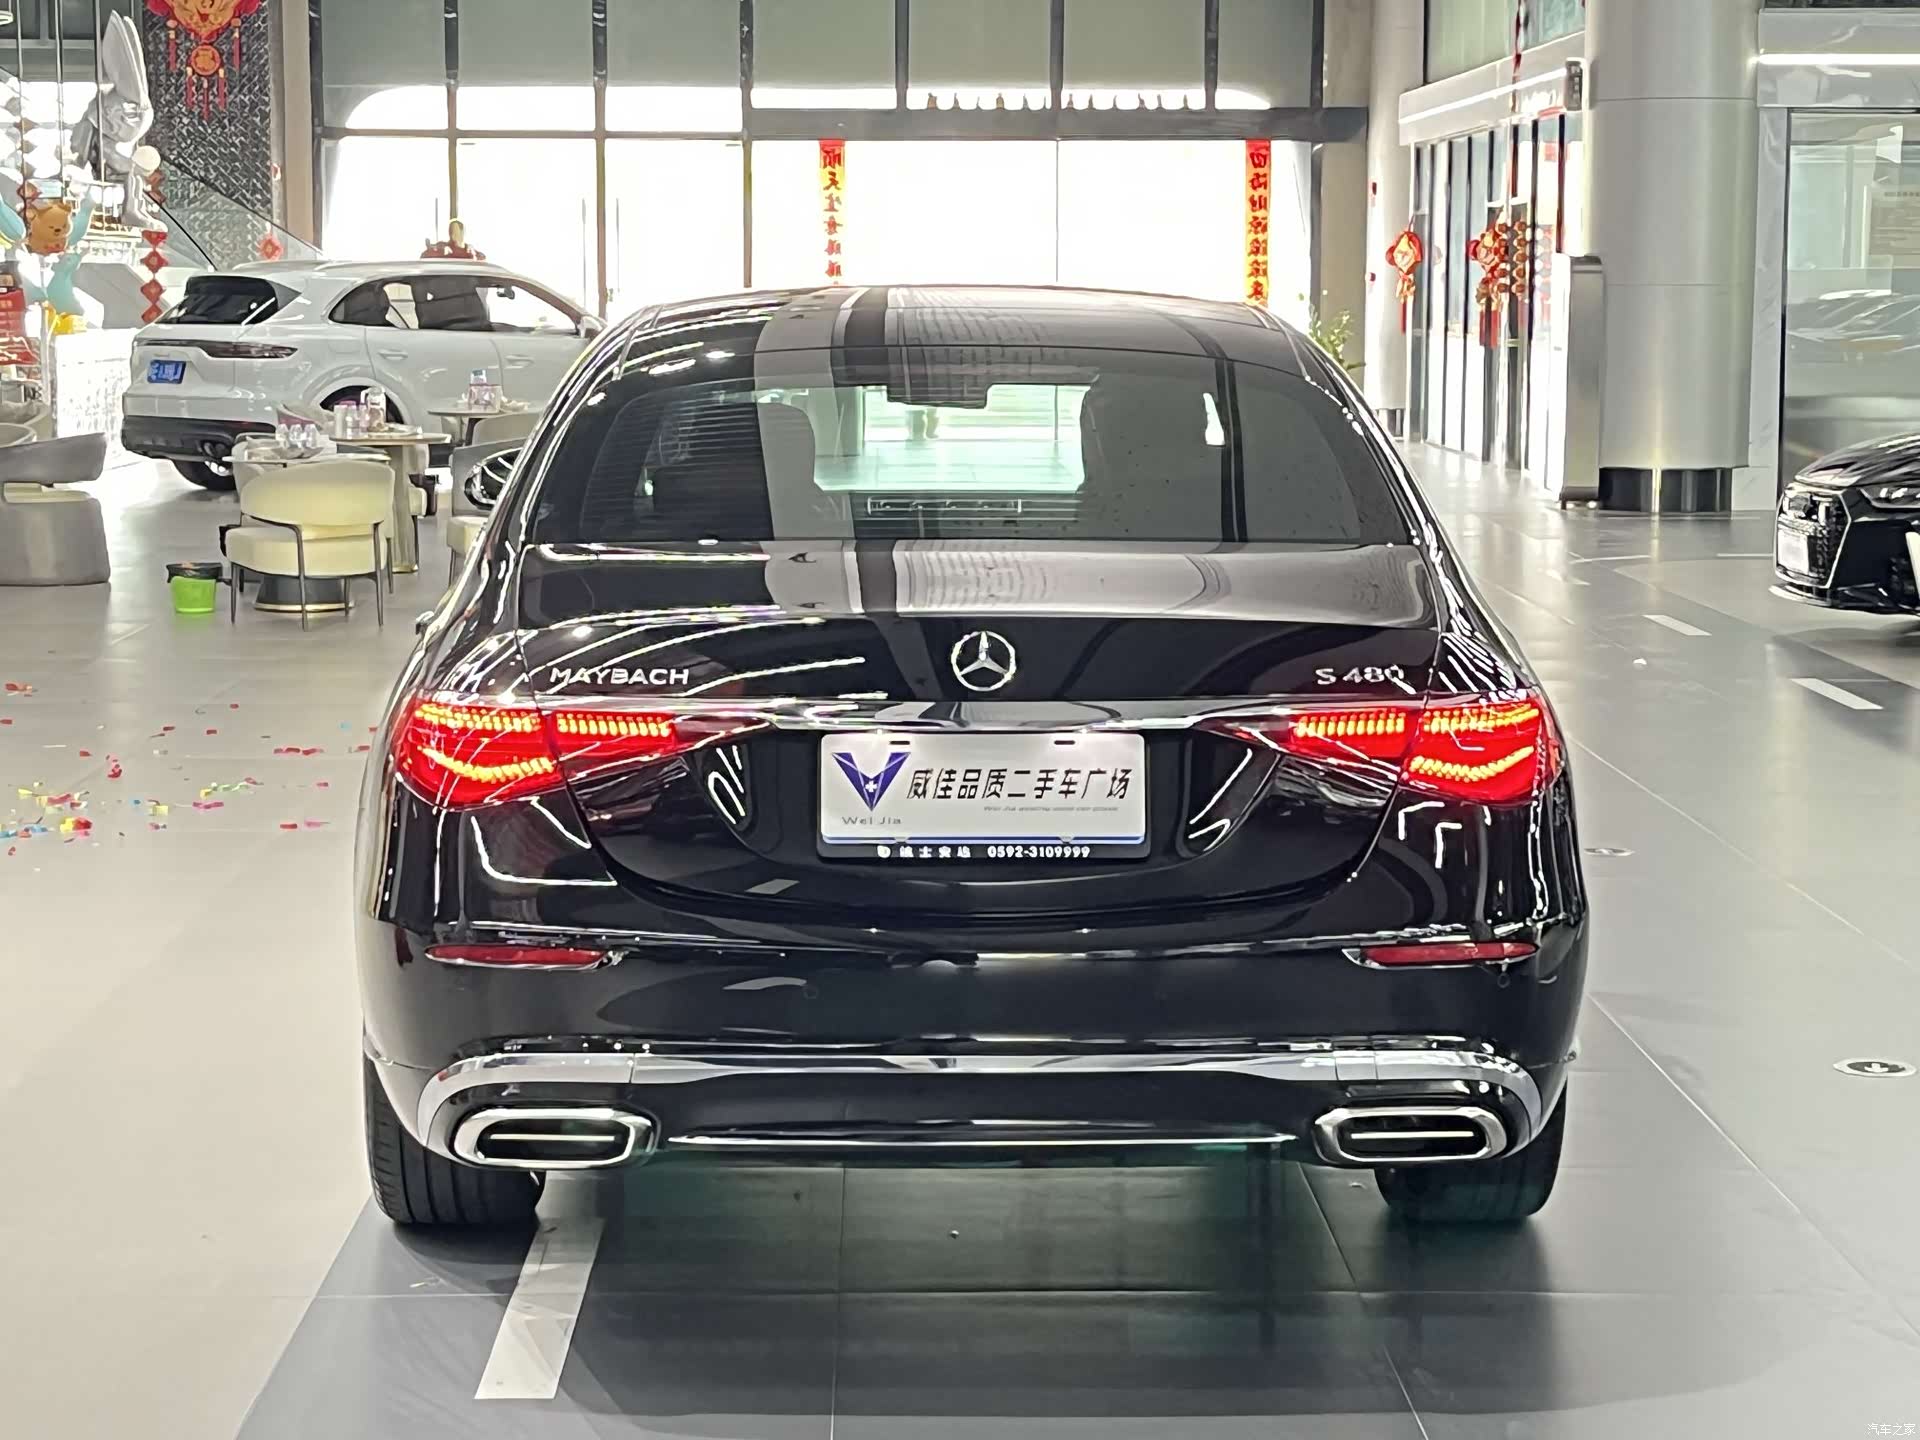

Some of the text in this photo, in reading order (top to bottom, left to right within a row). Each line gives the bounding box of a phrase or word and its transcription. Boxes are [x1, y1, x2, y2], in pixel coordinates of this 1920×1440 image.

[549, 667, 690, 685] MAYBACH
[1315, 664, 1405, 685] S 480
[906, 768, 1133, 799] 威佳品质二手车广场
[987, 845, 1091, 859] 0592-3109999
